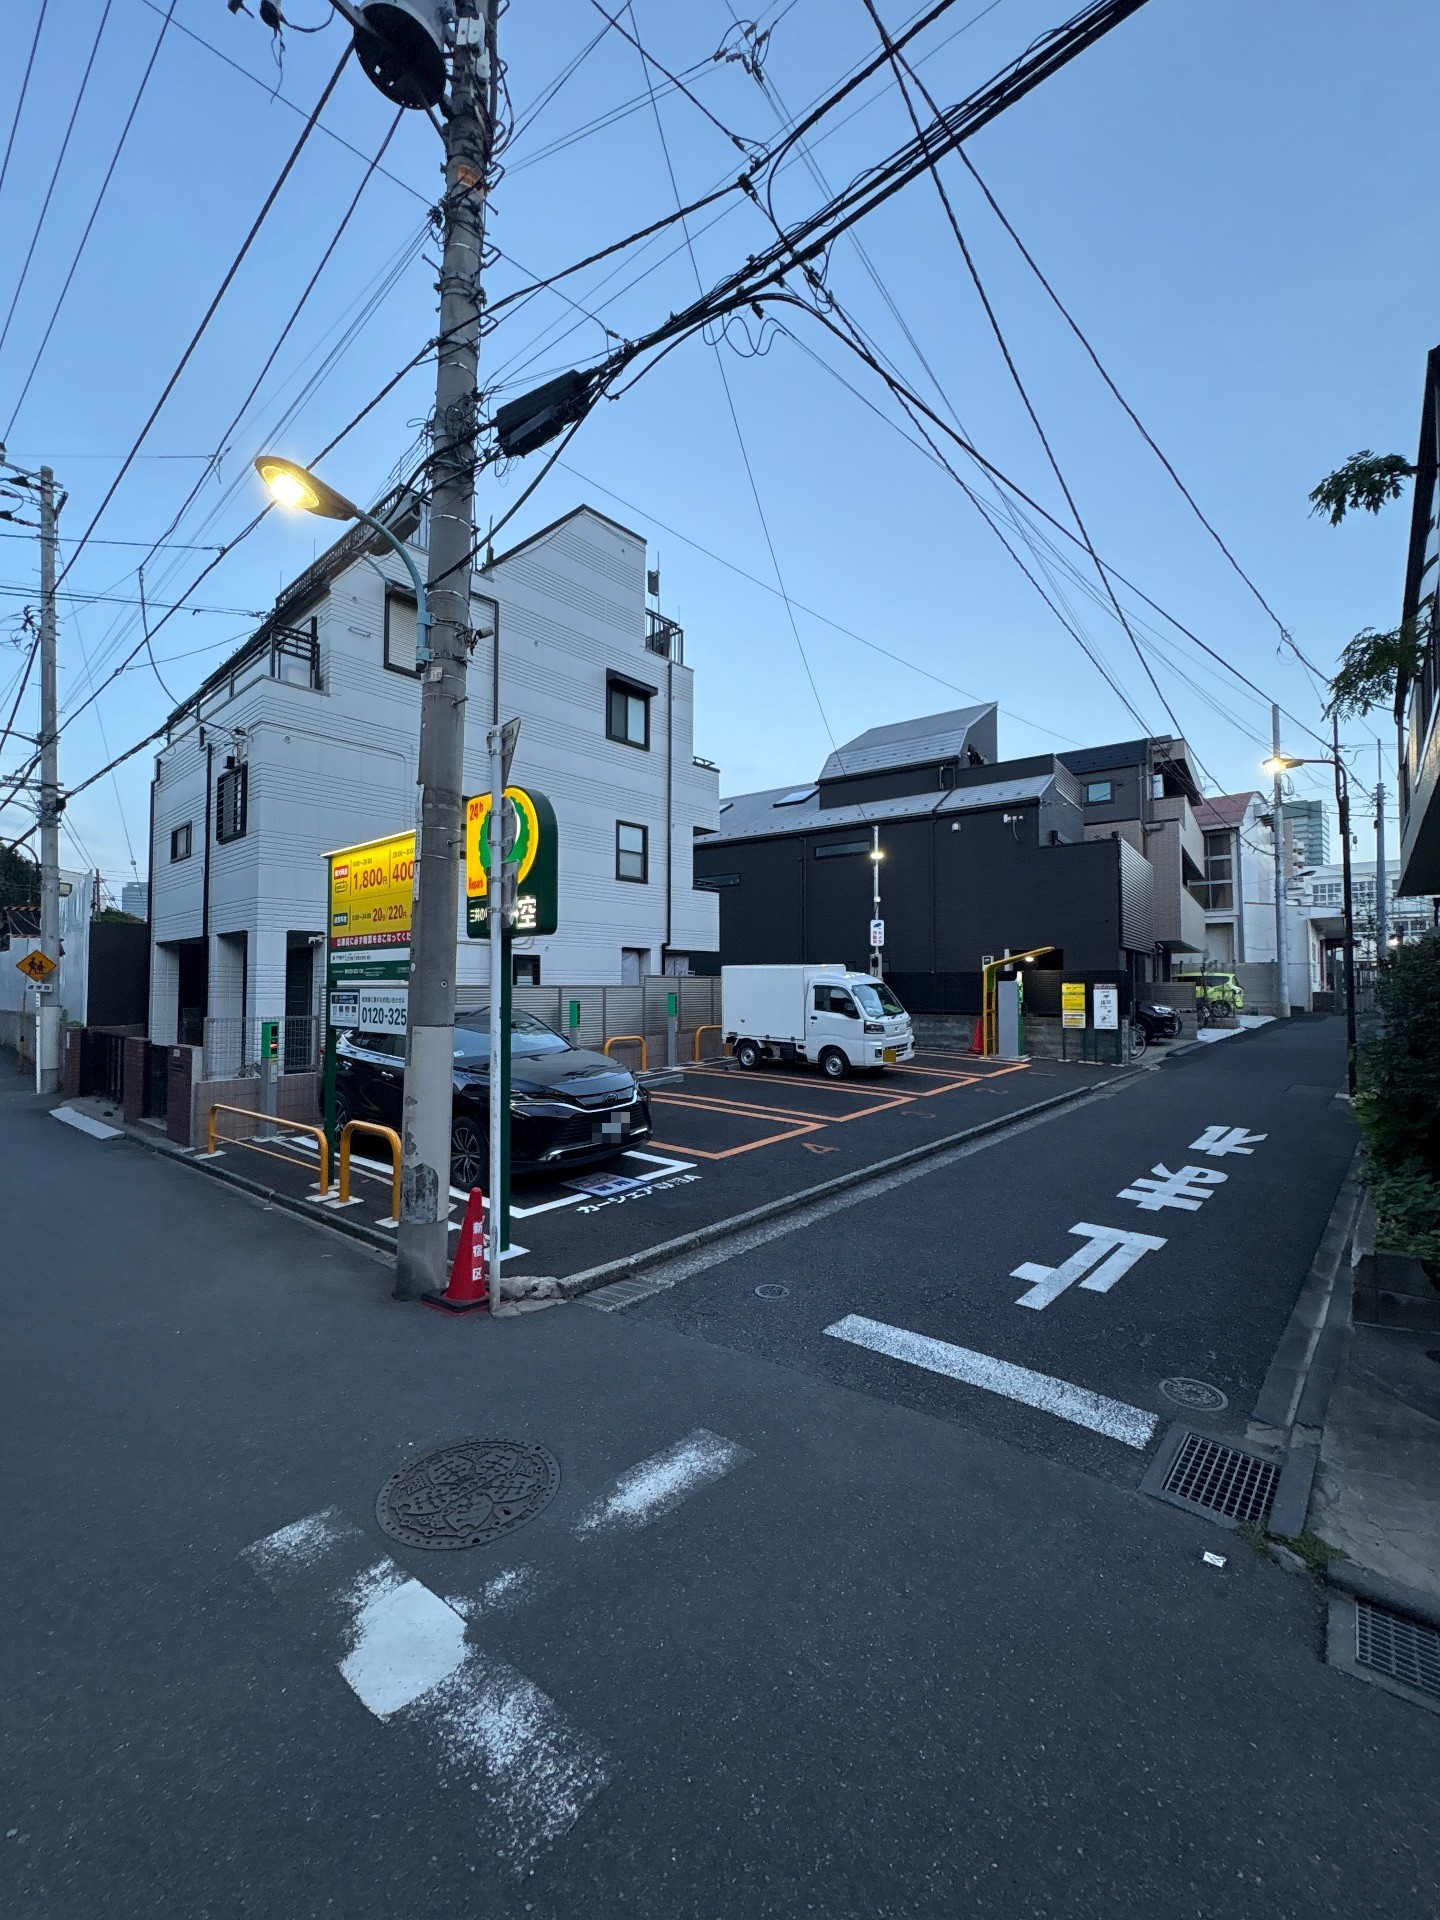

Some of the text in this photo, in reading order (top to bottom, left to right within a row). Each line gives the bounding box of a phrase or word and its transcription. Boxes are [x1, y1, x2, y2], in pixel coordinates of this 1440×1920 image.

[472, 1221, 483, 1281] 新宿区
[1009, 1125, 1269, 1311] 止まれ
